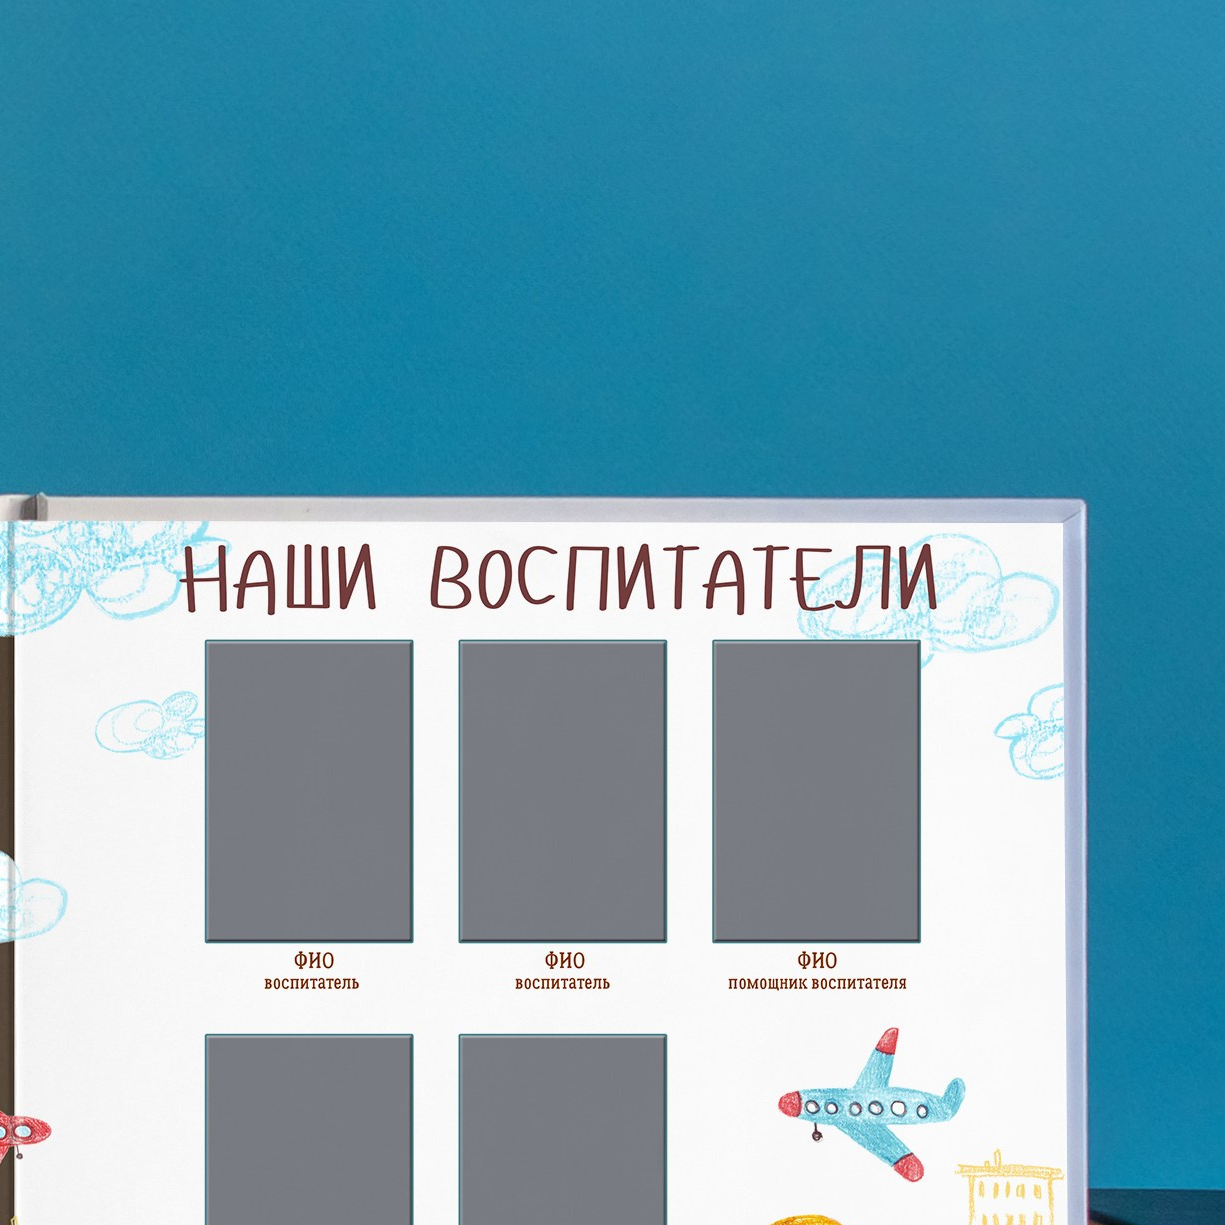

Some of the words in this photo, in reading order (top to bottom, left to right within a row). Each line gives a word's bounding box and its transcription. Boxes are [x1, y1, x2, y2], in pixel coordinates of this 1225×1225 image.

[180, 543, 377, 616] НАШИ
[429, 543, 938, 616] ВОСПИТАТЕЛИ
[294, 950, 335, 970] ФИО
[544, 950, 586, 970] ФИО
[797, 950, 838, 970] ФИО
[264, 977, 360, 990] воспитатель
[514, 977, 611, 990] воспитатель
[728, 977, 808, 992] помощник
[811, 977, 907, 991] воспитателя
